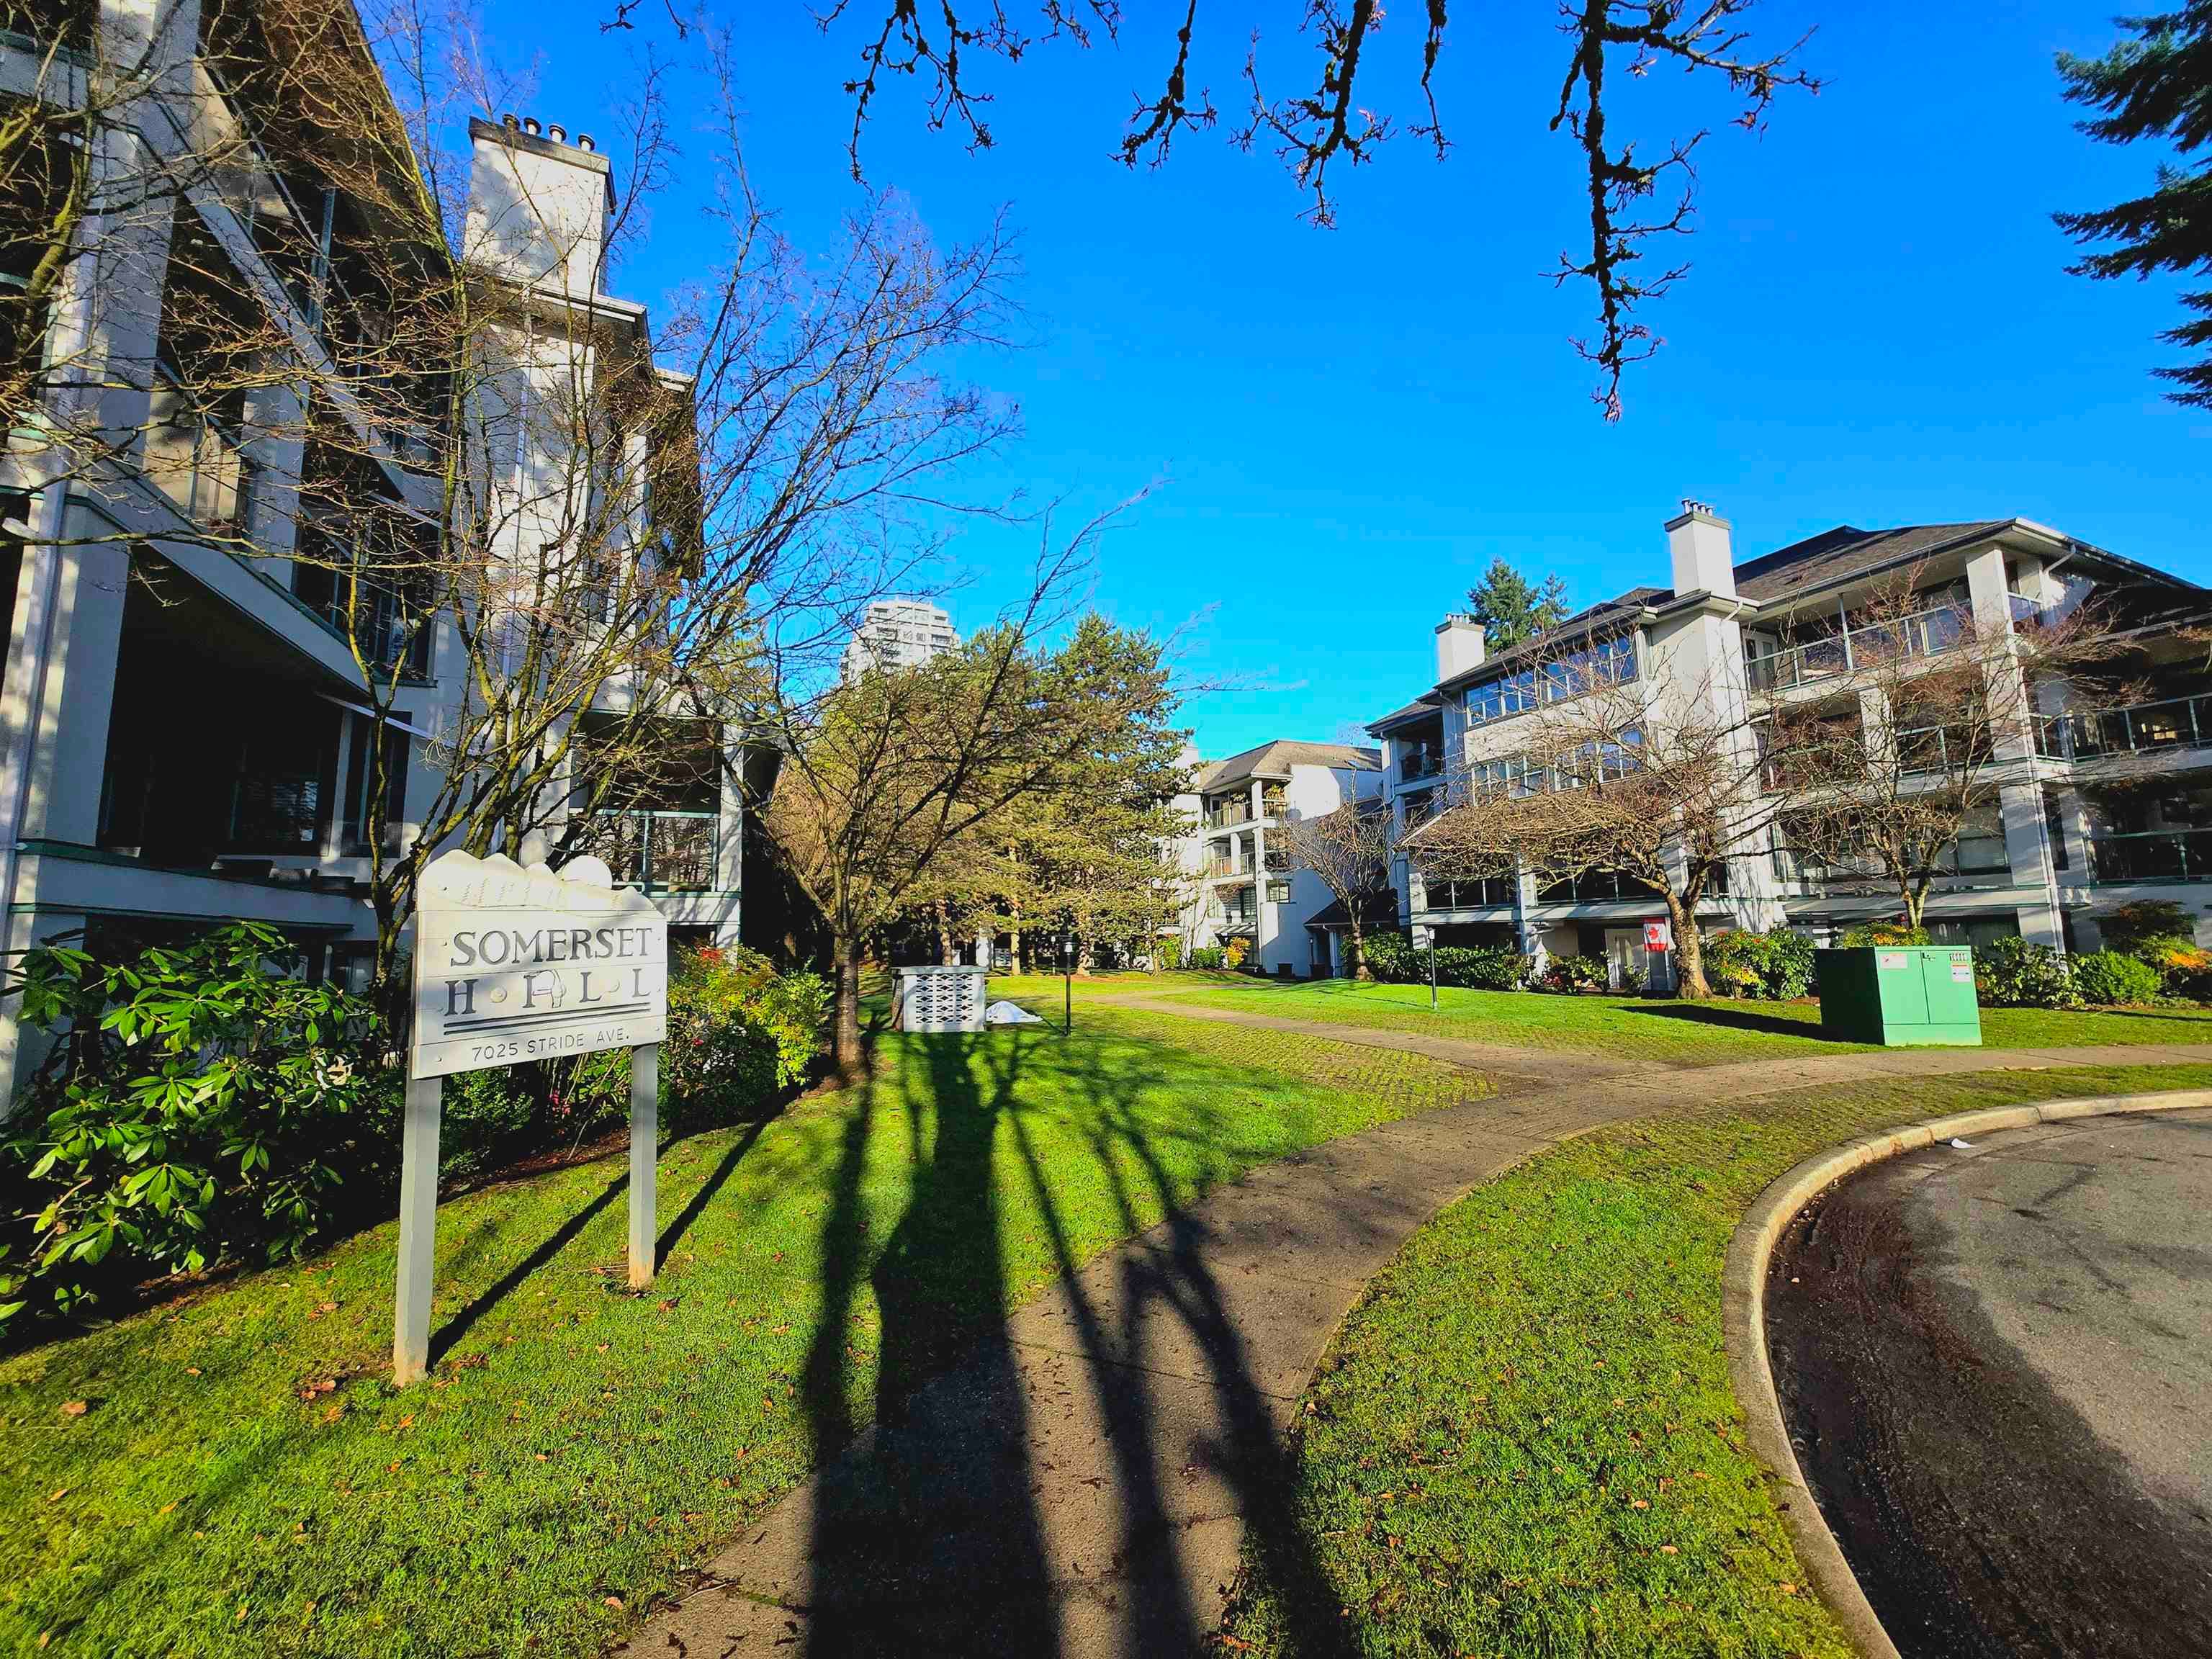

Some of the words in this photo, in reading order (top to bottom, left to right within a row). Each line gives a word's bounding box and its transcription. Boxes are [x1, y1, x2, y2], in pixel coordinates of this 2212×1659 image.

[450, 928, 652, 966] SOMERSET
[472, 1042, 518, 1061] 7025
[527, 1033, 585, 1053] STRIDE
[596, 1028, 630, 1043] AVE.
